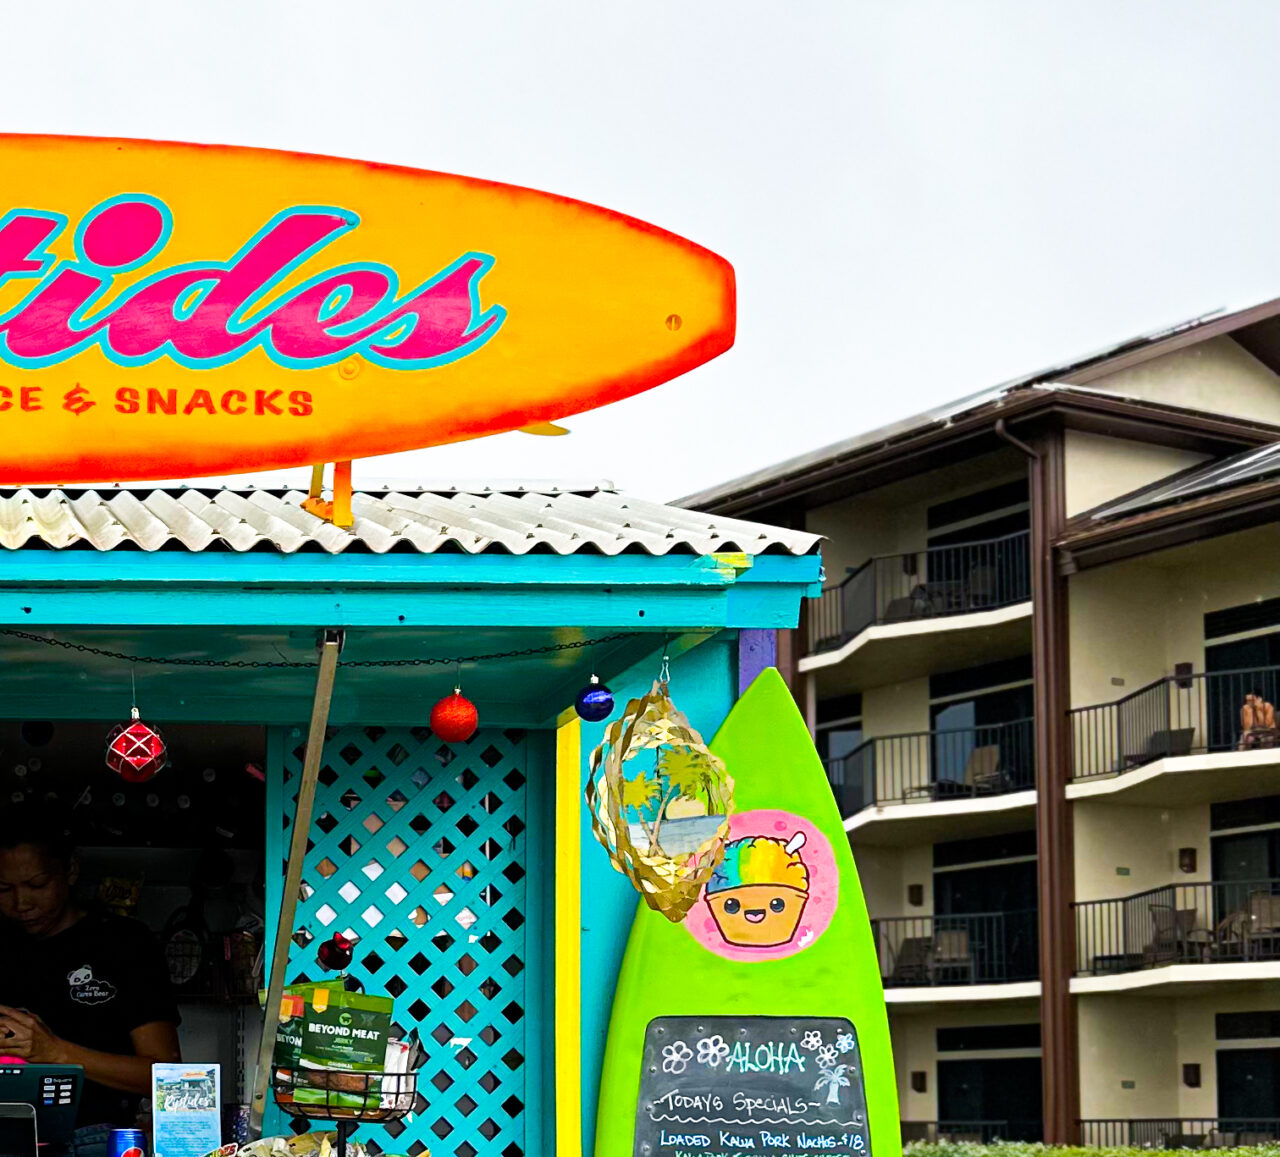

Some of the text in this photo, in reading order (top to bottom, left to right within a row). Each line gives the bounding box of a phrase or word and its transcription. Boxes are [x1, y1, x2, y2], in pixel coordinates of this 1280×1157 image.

[61, 383, 95, 416] &
[115, 384, 315, 417] SNACKS
[309, 1023, 381, 1040] BEYOND MEAT
[726, 1042, 806, 1075] ALOHA
[659, 1130, 711, 1147] LOADED
[760, 1131, 790, 1148] PORK
